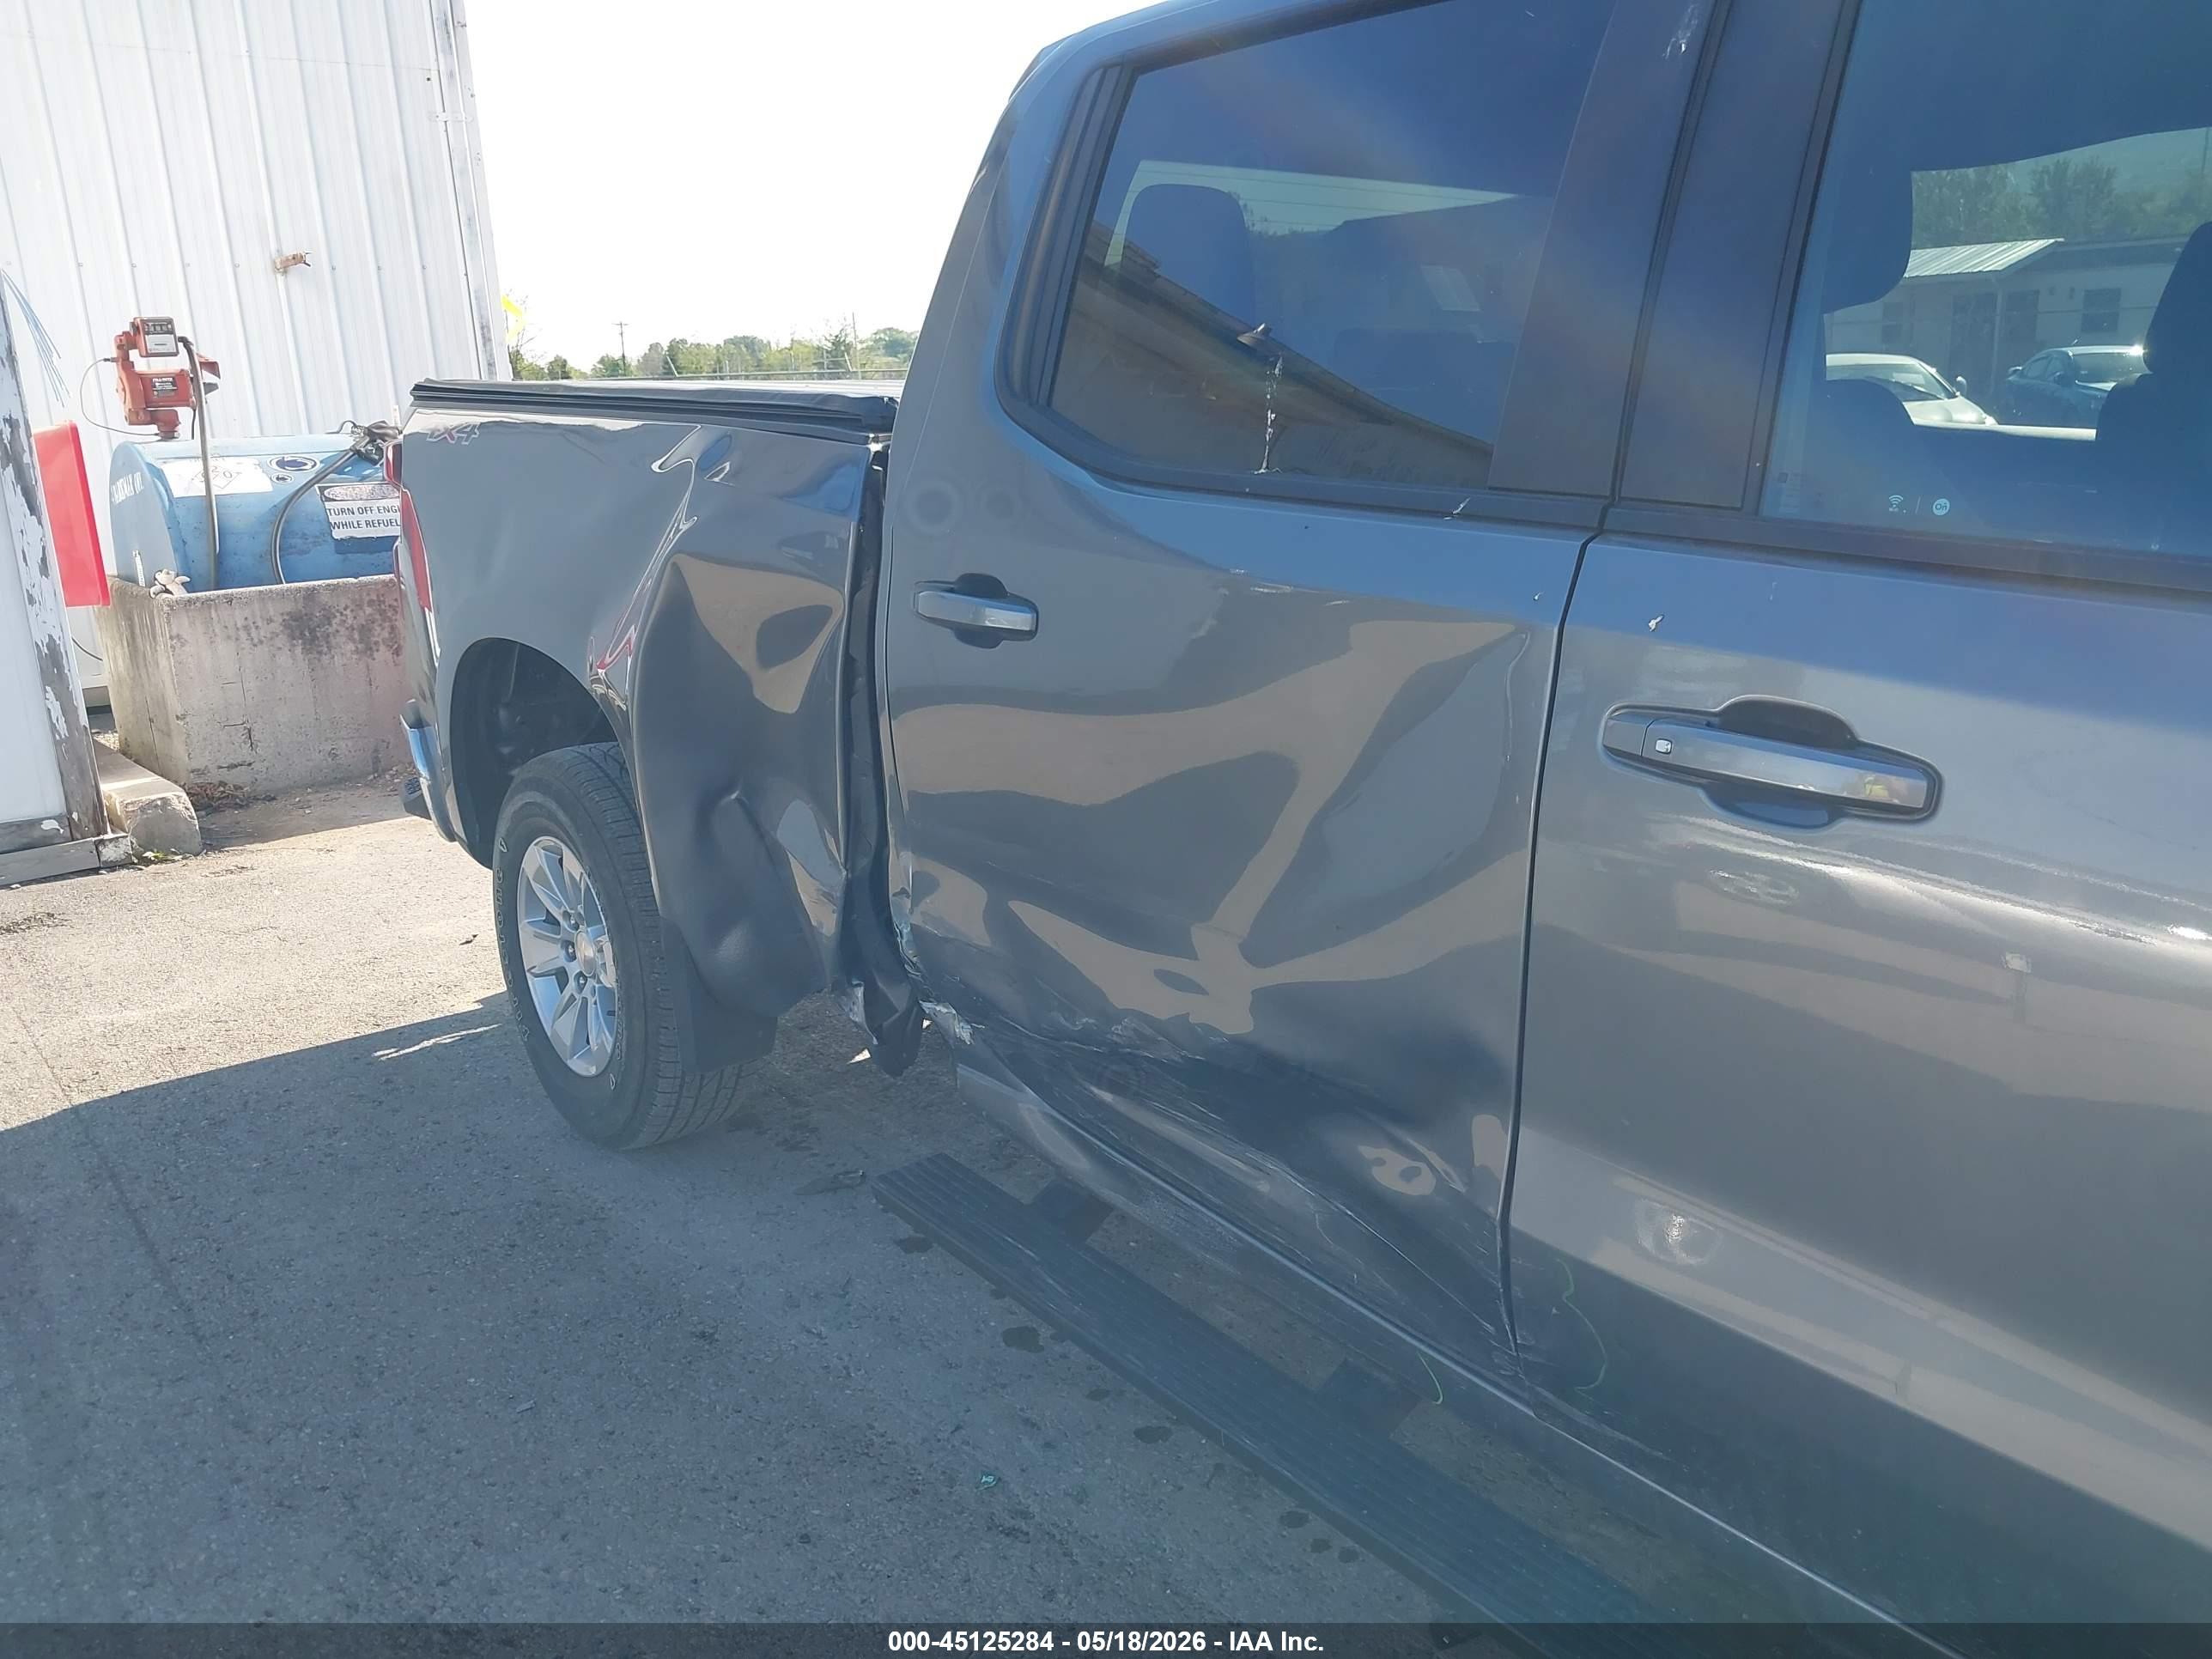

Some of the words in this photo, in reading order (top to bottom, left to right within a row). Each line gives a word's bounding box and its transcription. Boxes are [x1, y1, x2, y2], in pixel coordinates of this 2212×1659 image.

[326, 506, 356, 517] TURN
[356, 505, 375, 516] OFF
[331, 520, 363, 531] WHILE
